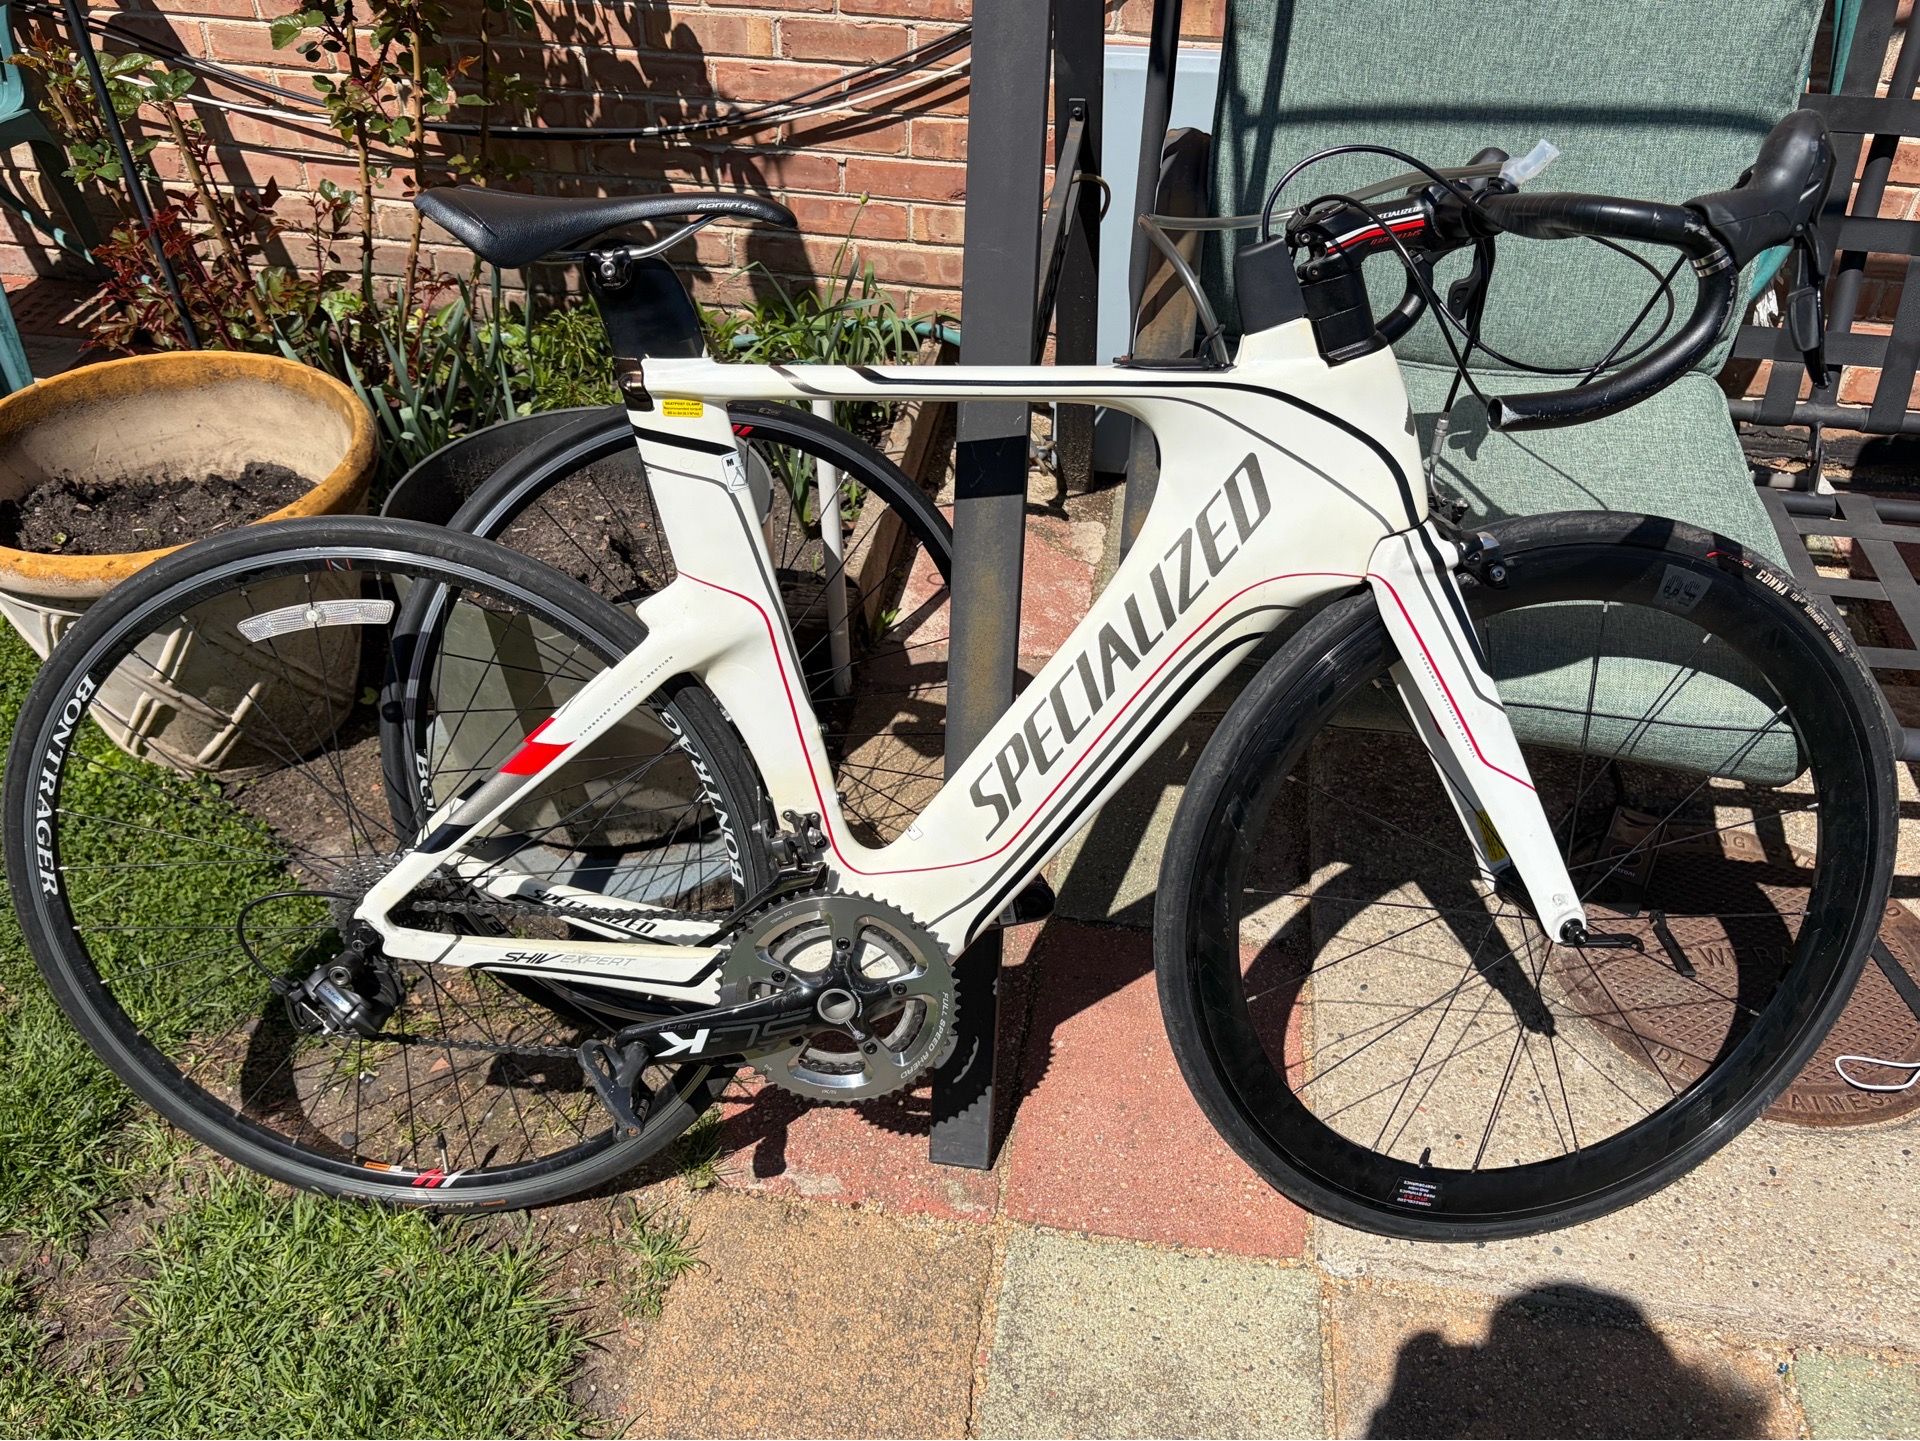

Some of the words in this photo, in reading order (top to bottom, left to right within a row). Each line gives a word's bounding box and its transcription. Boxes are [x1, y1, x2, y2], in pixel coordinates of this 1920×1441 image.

[1368, 206, 1424, 222] SECIALIZED
[726, 458, 735, 467] M
[968, 452, 1272, 842] SPECIALIZED
[35, 673, 97, 896] BONTRAGER
[659, 711, 745, 888] BONTRAG
[498, 952, 562, 965] SHIV
[559, 955, 637, 967] EXPERT
[941, 991, 949, 1016] FULL
[928, 1018, 946, 1052] SPEED
[900, 1051, 930, 1079] AHEAD
